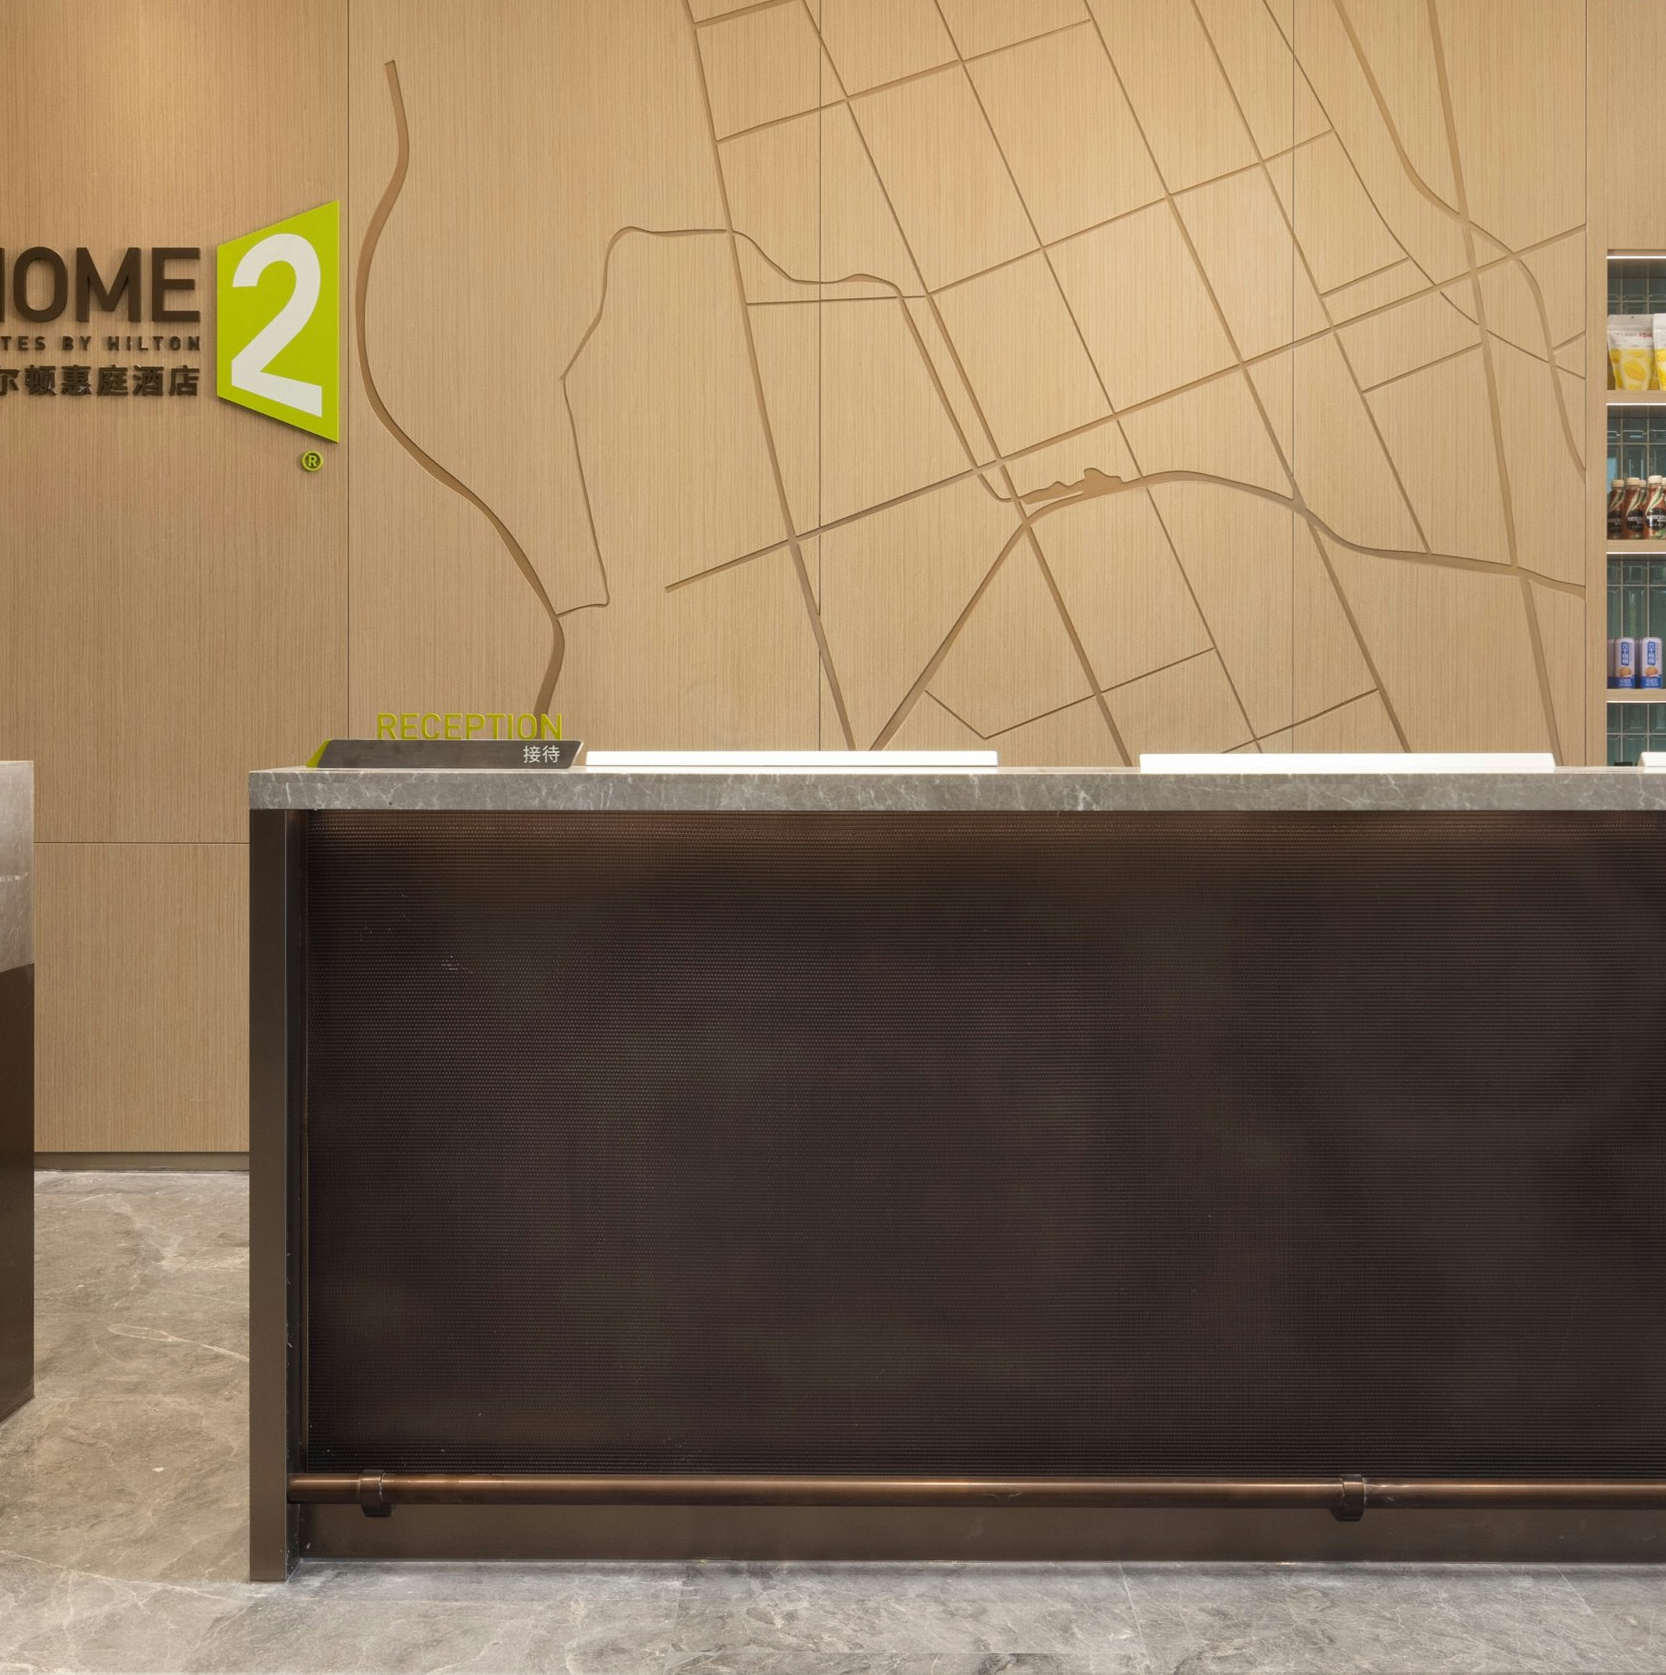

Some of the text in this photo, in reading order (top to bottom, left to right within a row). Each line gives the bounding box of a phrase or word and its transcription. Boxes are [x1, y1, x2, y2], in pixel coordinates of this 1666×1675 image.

[231, 232, 323, 418] 2
[62, 335, 93, 352] BY
[108, 335, 201, 352] HILTON
[376, 712, 563, 741] RECEPTION
[522, 744, 561, 764] 接待
